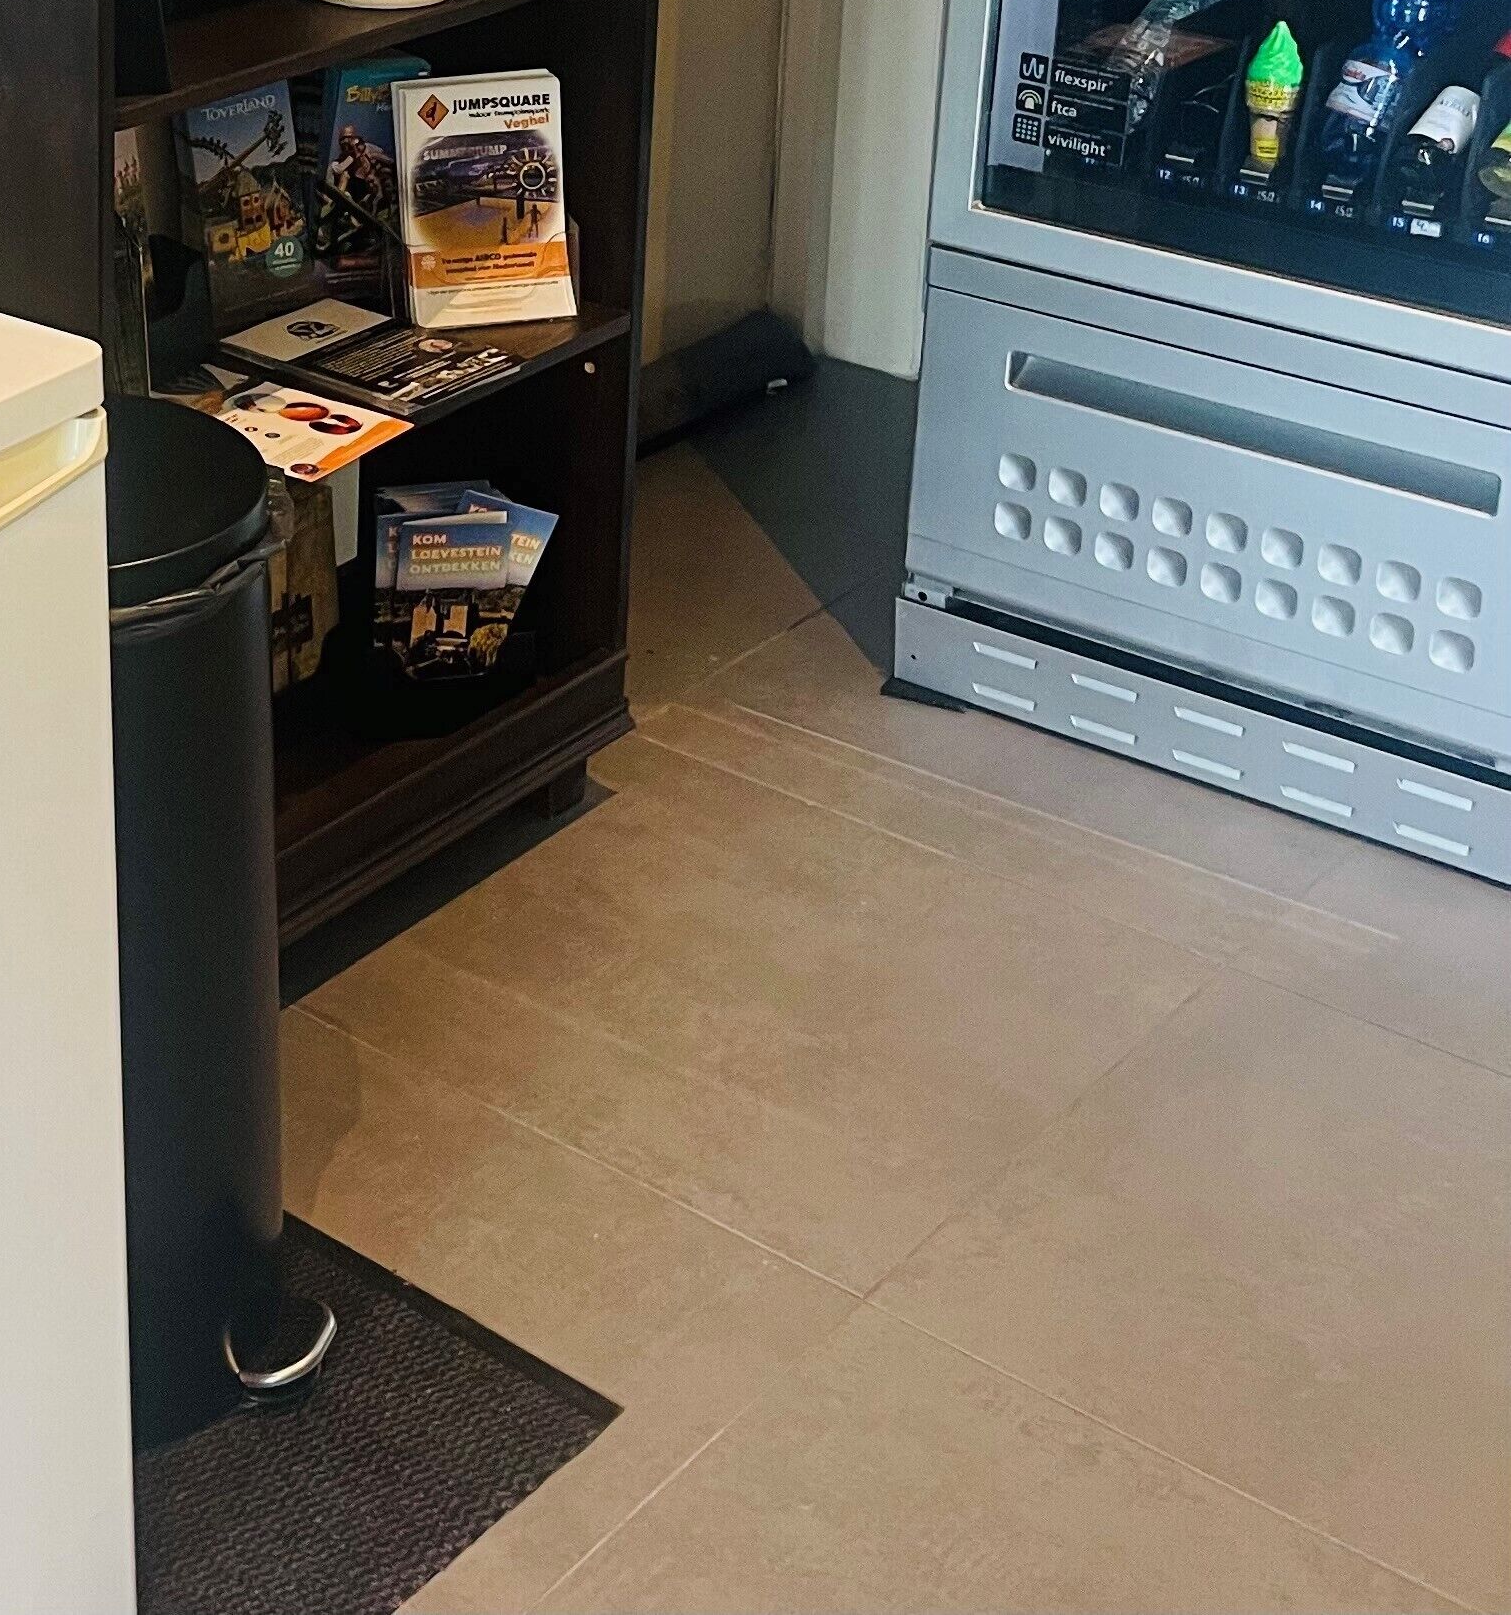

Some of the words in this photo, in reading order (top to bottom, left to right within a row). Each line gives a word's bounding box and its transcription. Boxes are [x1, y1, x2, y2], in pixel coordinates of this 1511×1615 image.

[1054, 69, 1108, 92] flexspir
[200, 94, 276, 122] TOVERLAND
[452, 93, 551, 115] JUMPSQUARE
[1051, 100, 1078, 118] ftca
[504, 114, 550, 129] Veghel
[1048, 133, 1106, 157] vivilight
[1310, 200, 1323, 211] 14
[1392, 216, 1405, 228] 15
[1477, 233, 1491, 244] 16
[274, 241, 295, 258] 40
[412, 534, 447, 546] KOM
[411, 545, 502, 560] LOEVESTEIN
[408, 559, 501, 575] ONTDEKKEN
